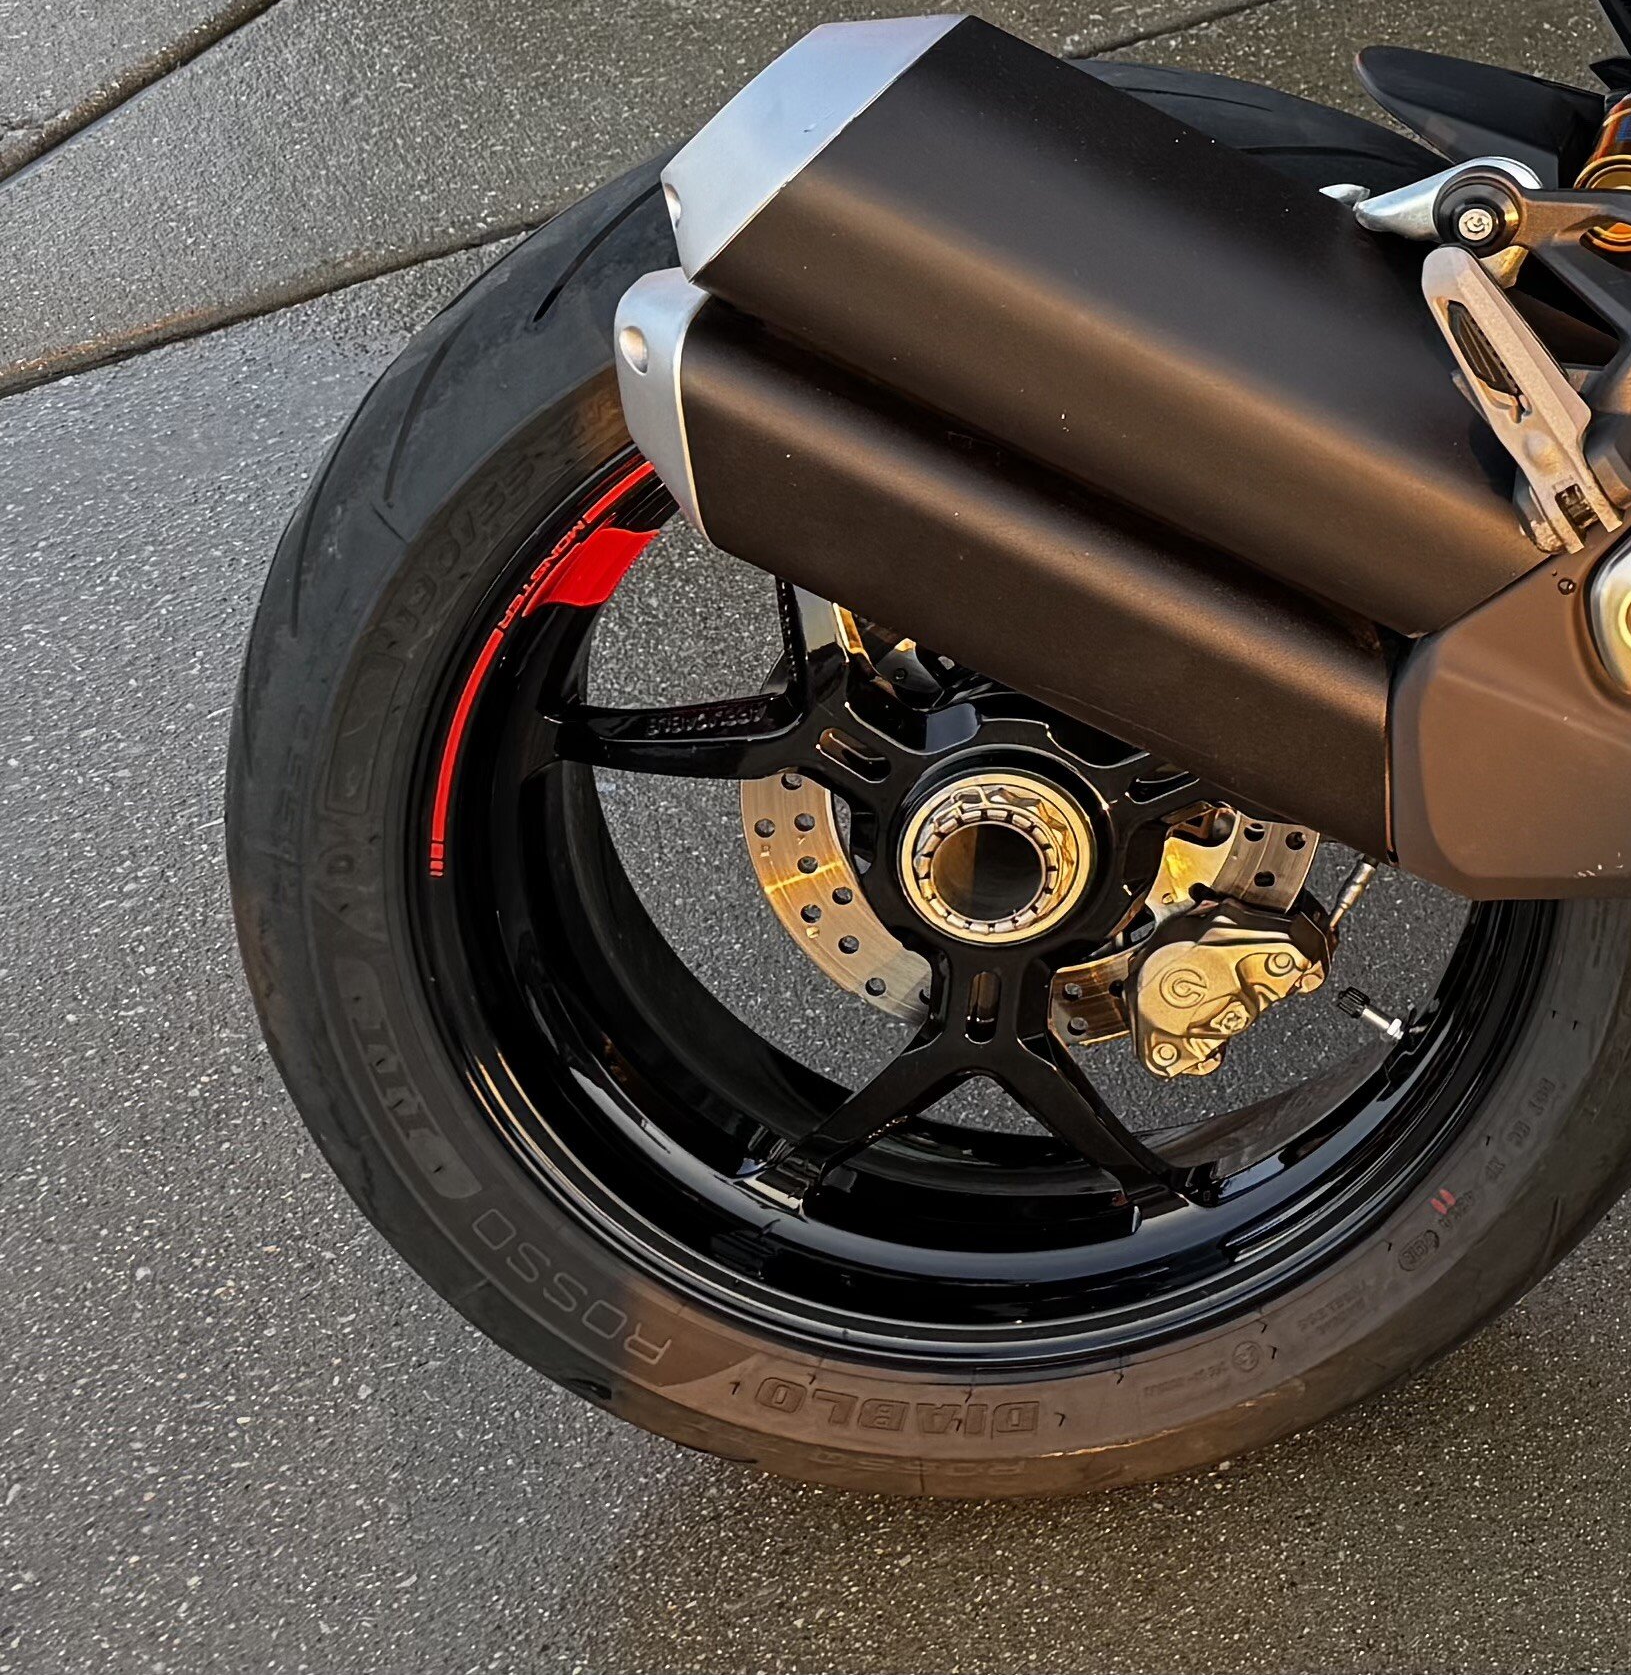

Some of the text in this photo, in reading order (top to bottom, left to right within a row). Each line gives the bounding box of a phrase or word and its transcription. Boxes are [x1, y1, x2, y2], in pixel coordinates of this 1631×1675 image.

[497, 519, 586, 630] MONSTER
[470, 1208, 672, 1367] ROSSO
[753, 1375, 1041, 1436] DIABLO
